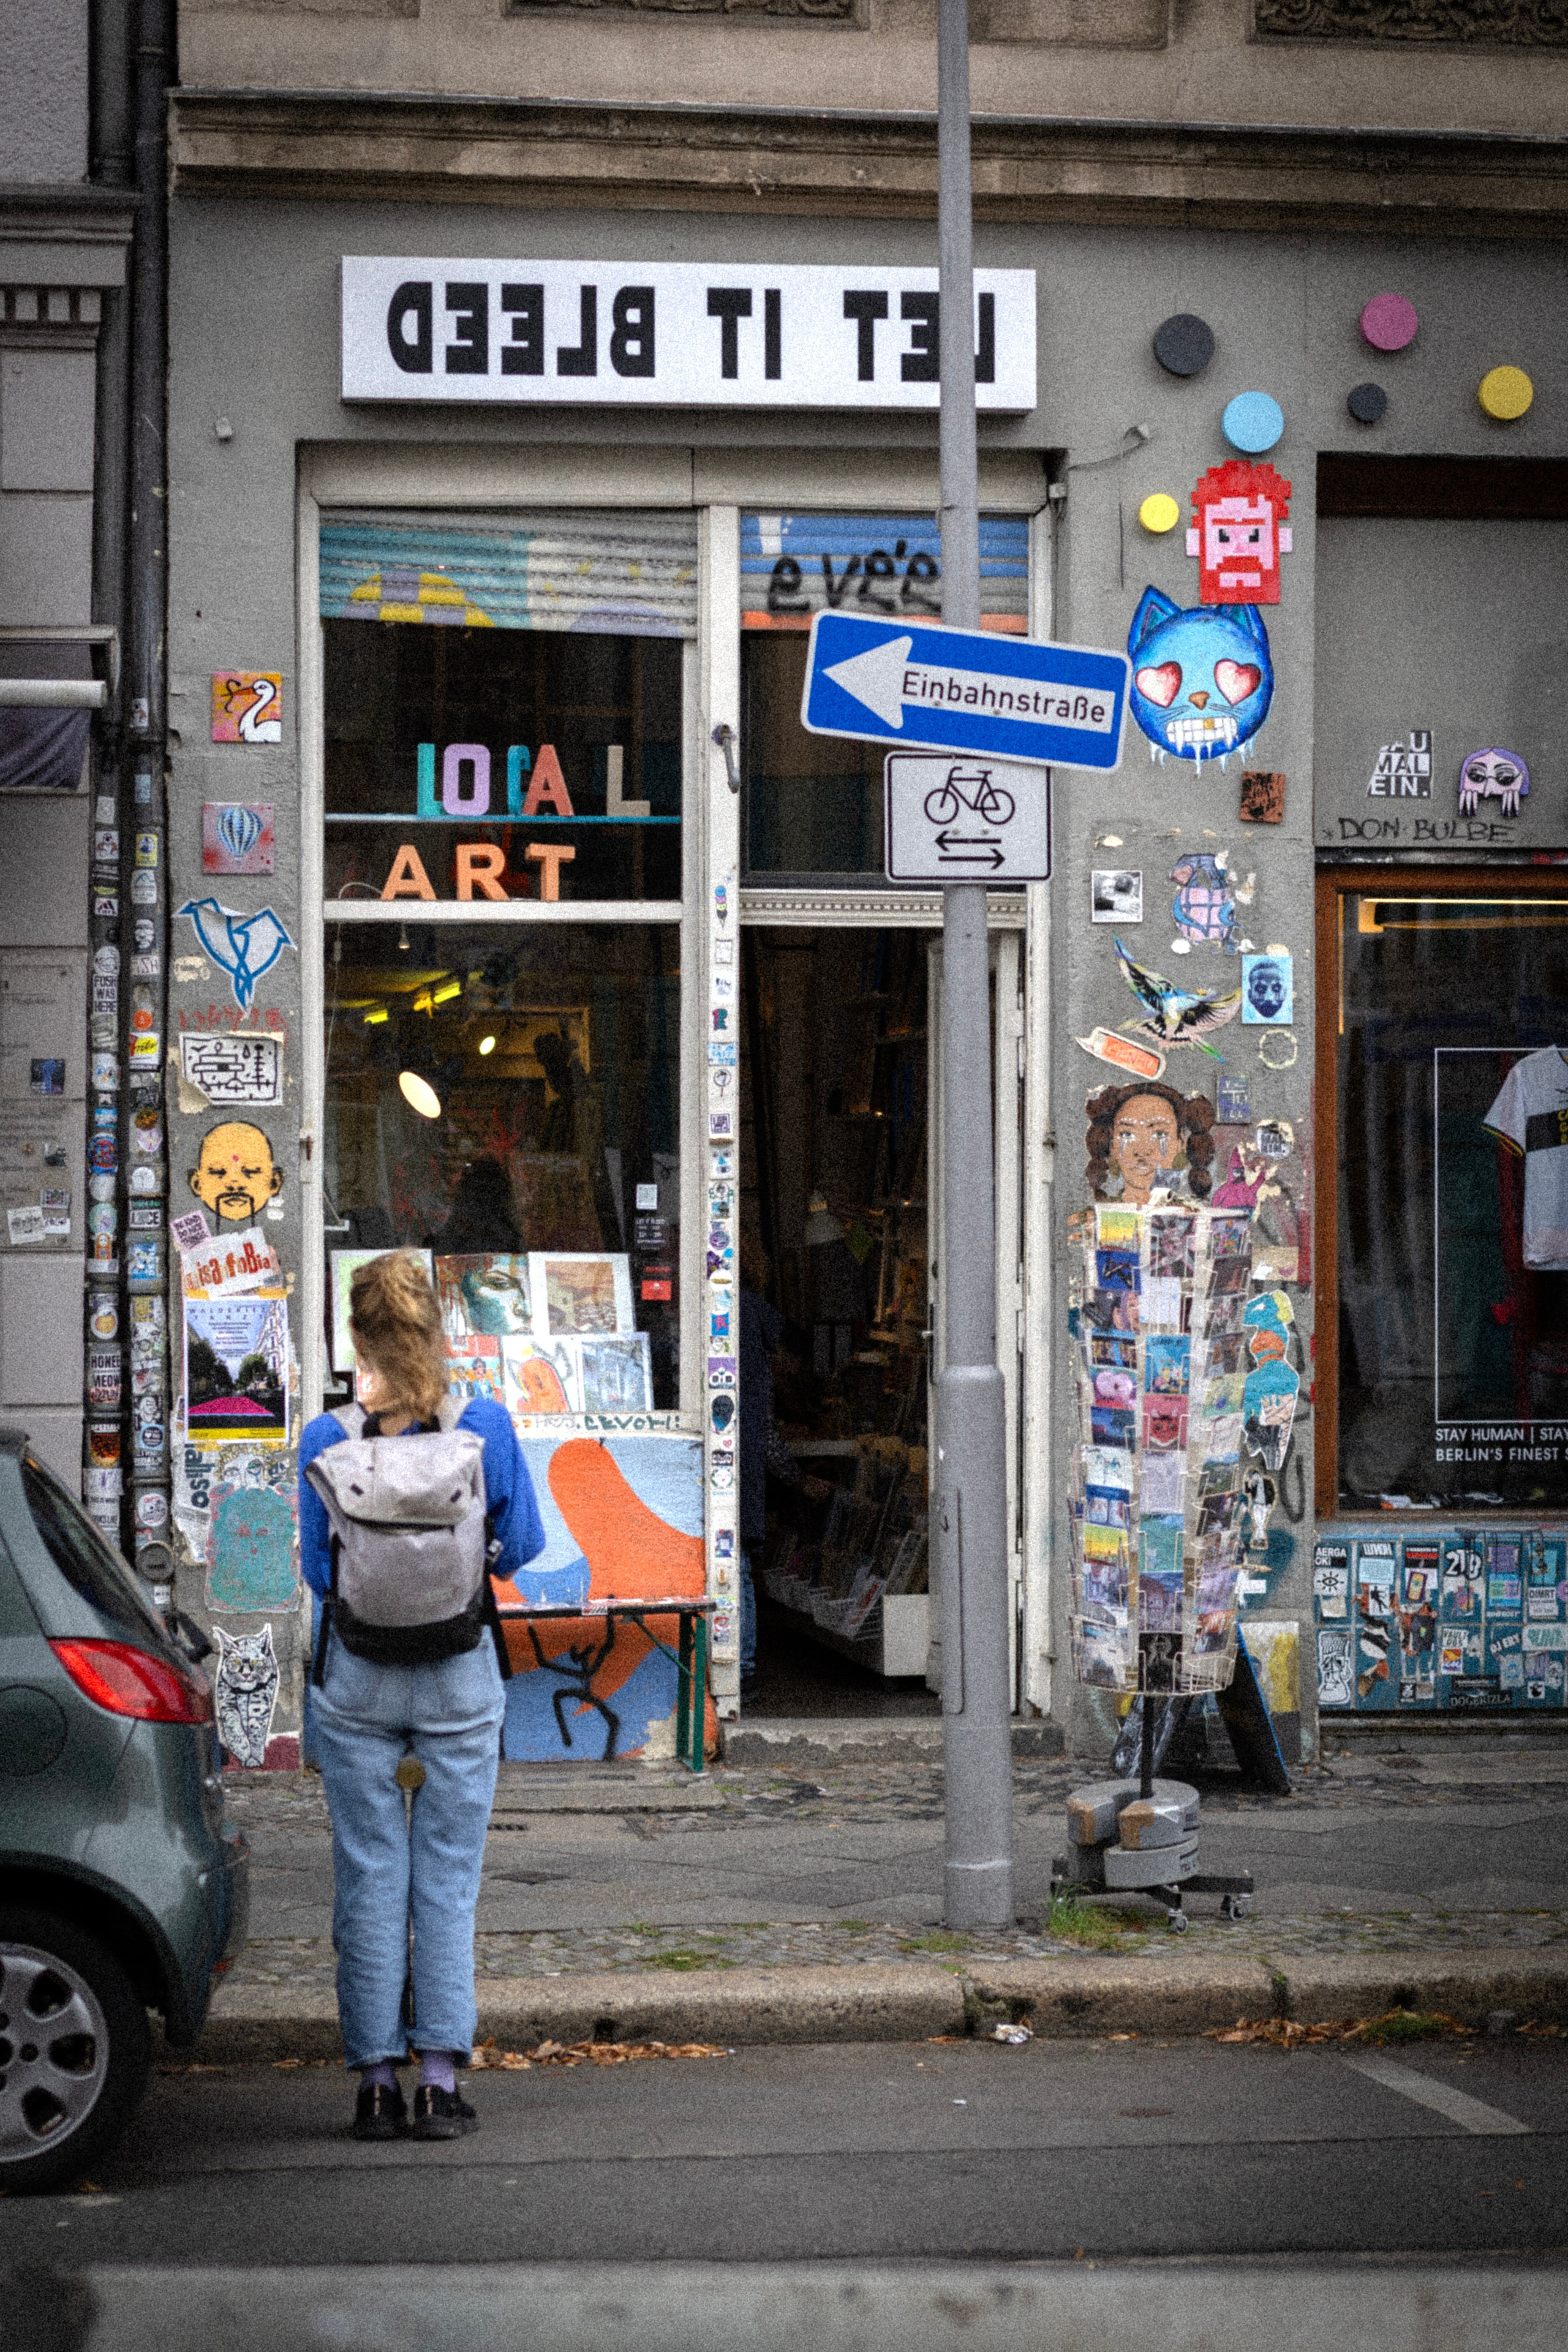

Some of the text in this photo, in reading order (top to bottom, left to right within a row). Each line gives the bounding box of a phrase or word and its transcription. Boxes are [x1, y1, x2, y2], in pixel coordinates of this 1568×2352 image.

[902, 671, 1106, 724] Einbahnstraße
[417, 742, 651, 817] LOCAL
[380, 843, 576, 901] ART
[1435, 1428, 1468, 1441] STAY
[1471, 1428, 1524, 1441] HUMAN
[1435, 1448, 1503, 1461] BERLIN'S
[1509, 1447, 1559, 1461] FINEST
